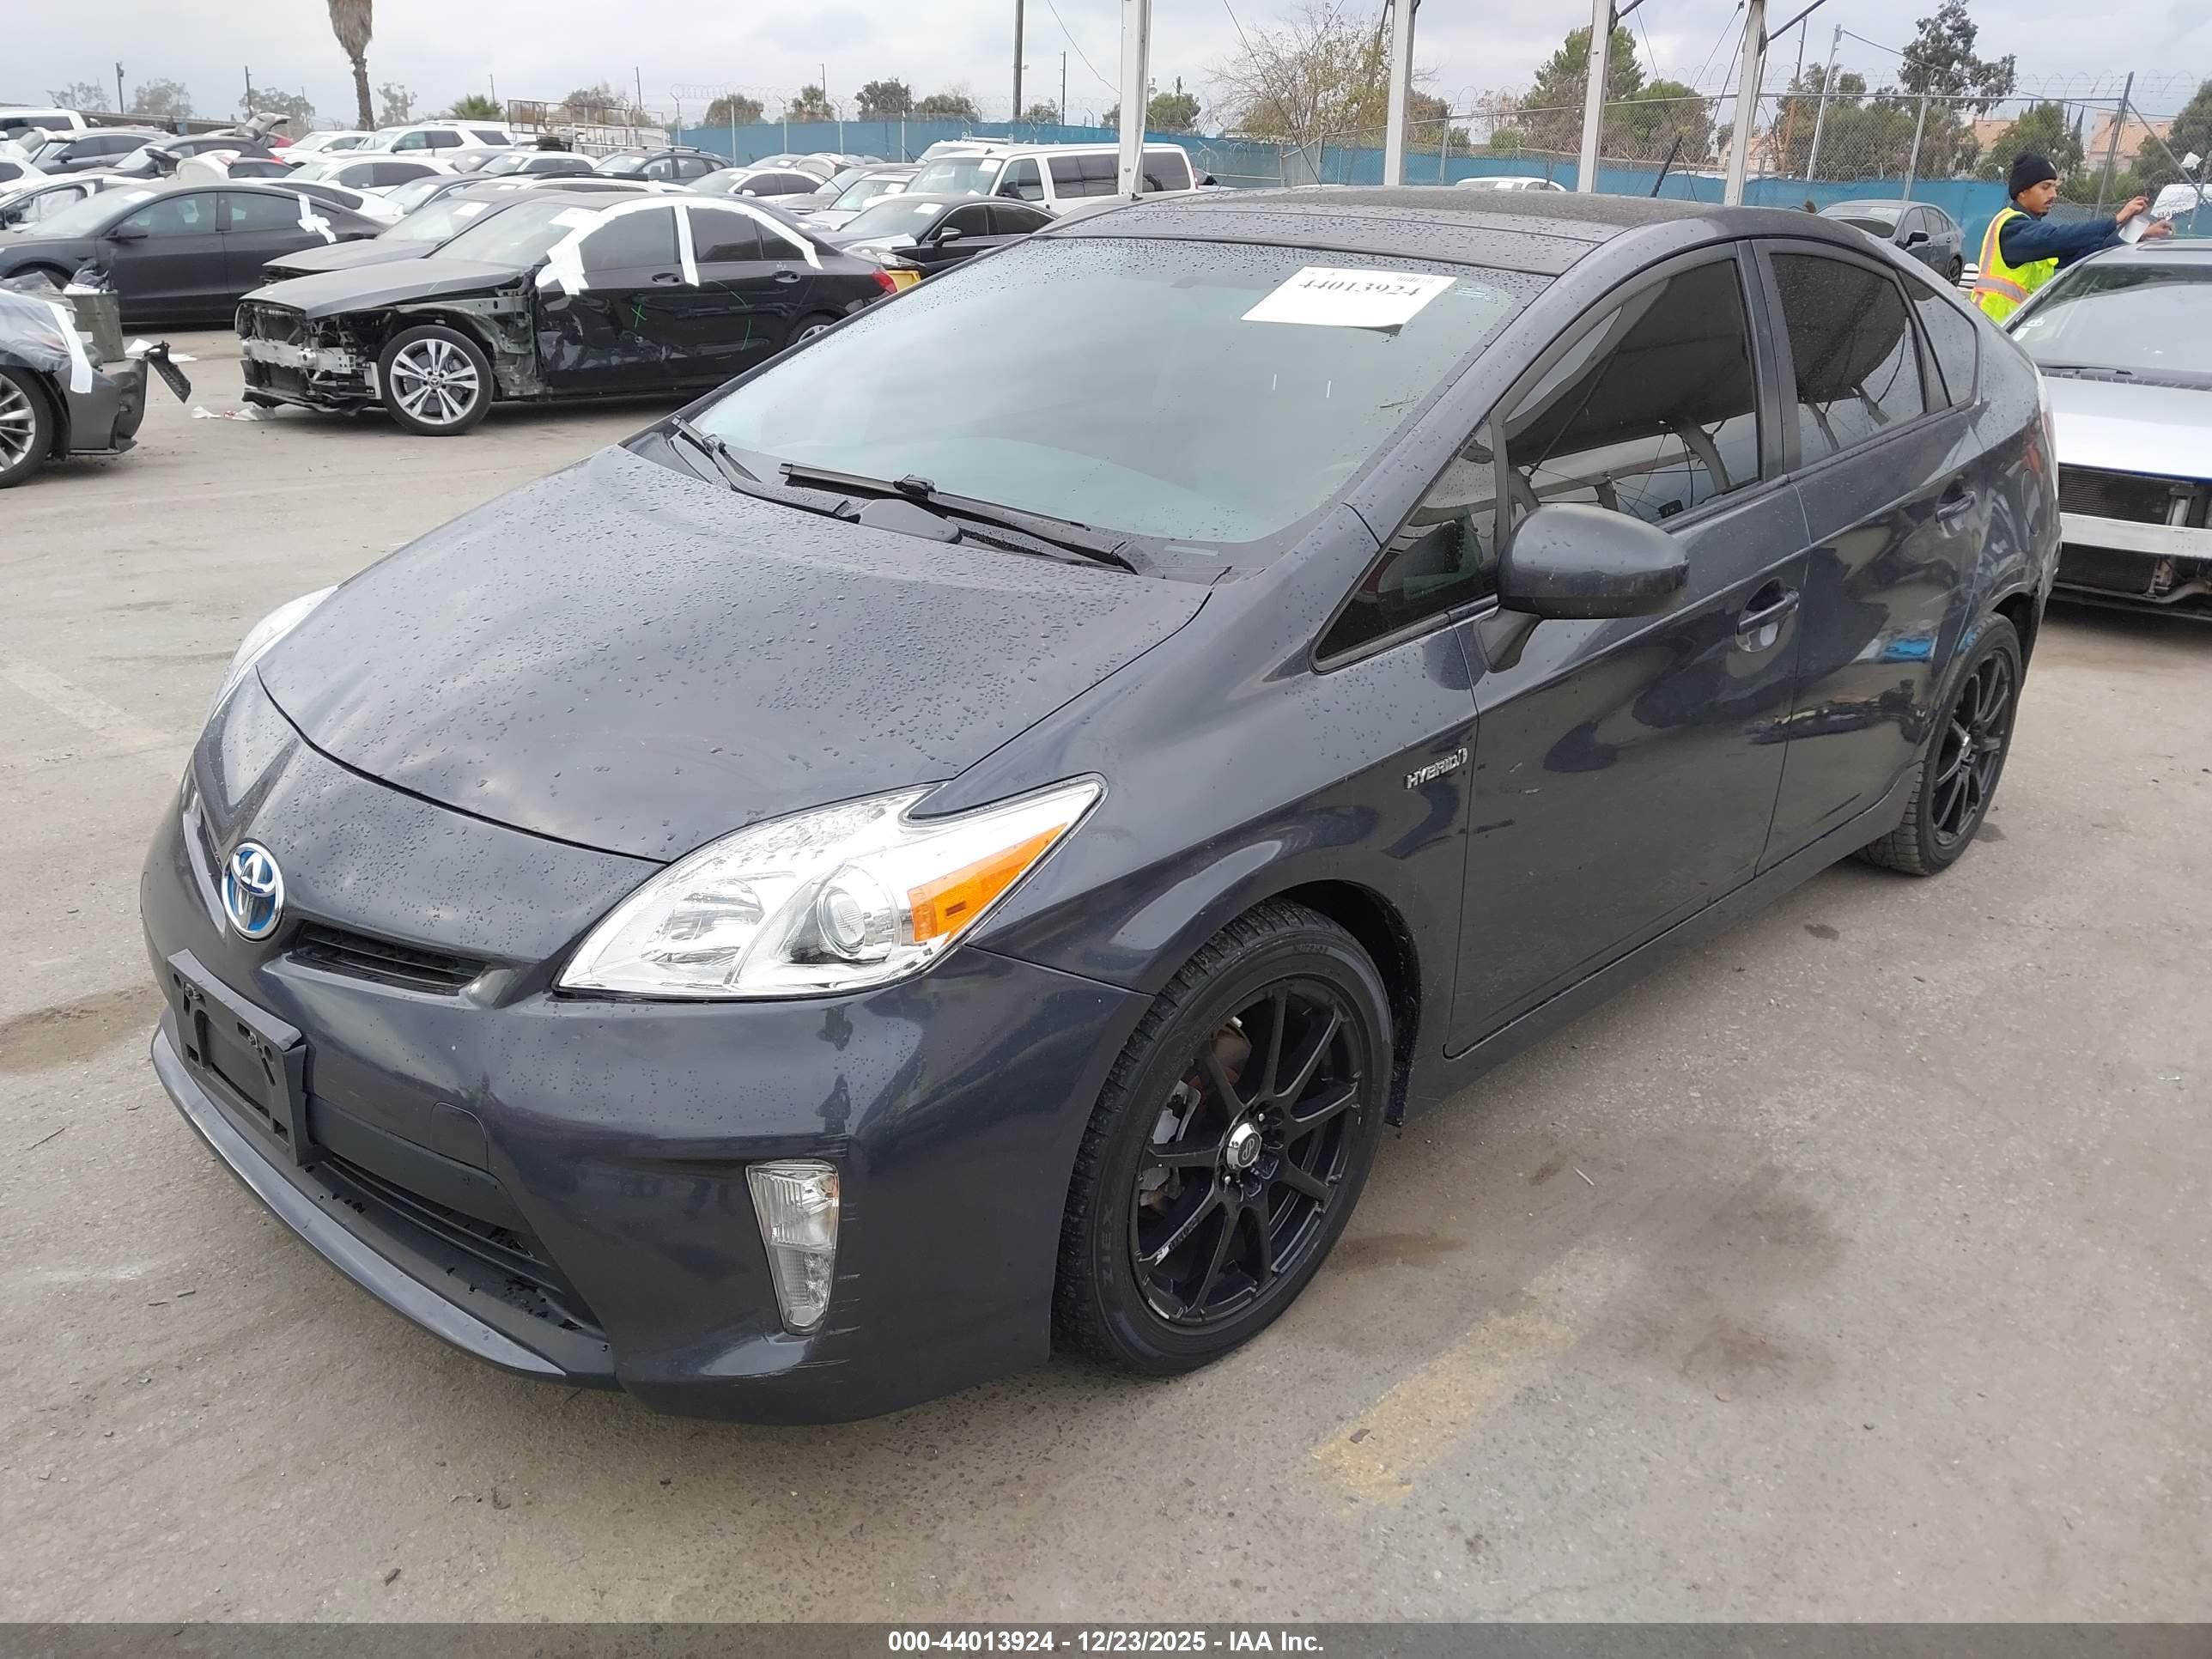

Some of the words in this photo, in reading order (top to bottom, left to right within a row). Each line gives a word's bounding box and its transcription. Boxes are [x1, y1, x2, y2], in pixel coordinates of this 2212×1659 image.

[1298, 279, 1422, 296] 44013924
[1405, 752, 1461, 789] HYBRID
[1100, 1203, 1114, 1285] ZIEX
